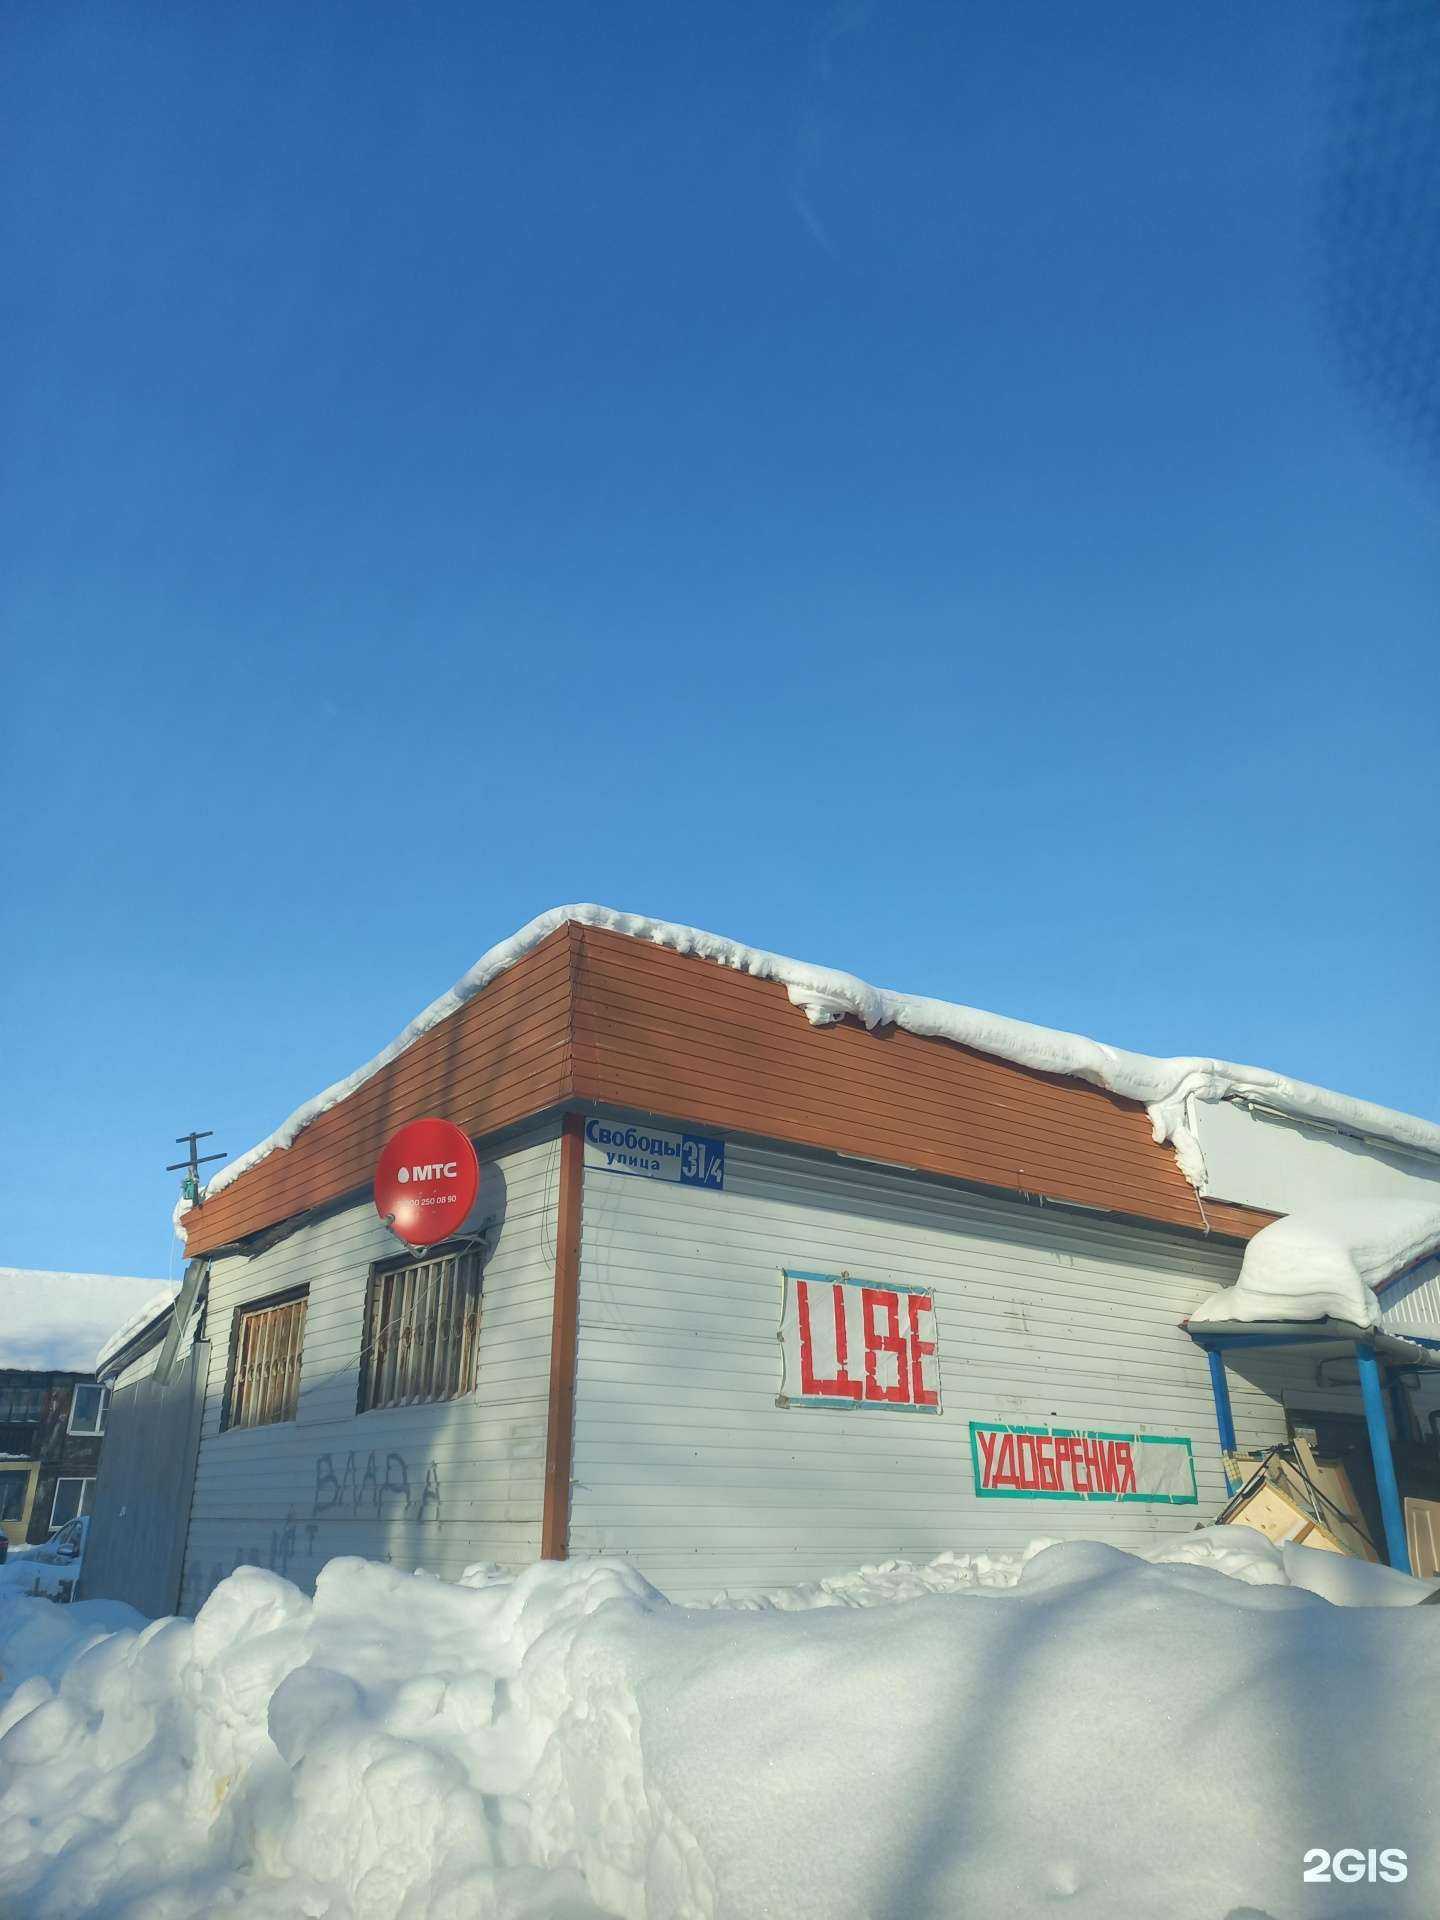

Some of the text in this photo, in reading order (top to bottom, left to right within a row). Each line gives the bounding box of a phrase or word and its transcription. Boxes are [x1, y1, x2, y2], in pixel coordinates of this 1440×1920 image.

[586, 1119, 722, 1183] Свободы 31/4
[606, 1151, 660, 1171] улица
[412, 1162, 457, 1181] МТС
[420, 1197, 435, 1206] 250
[976, 1431, 1137, 1493] УДОБРЕНИЯ
